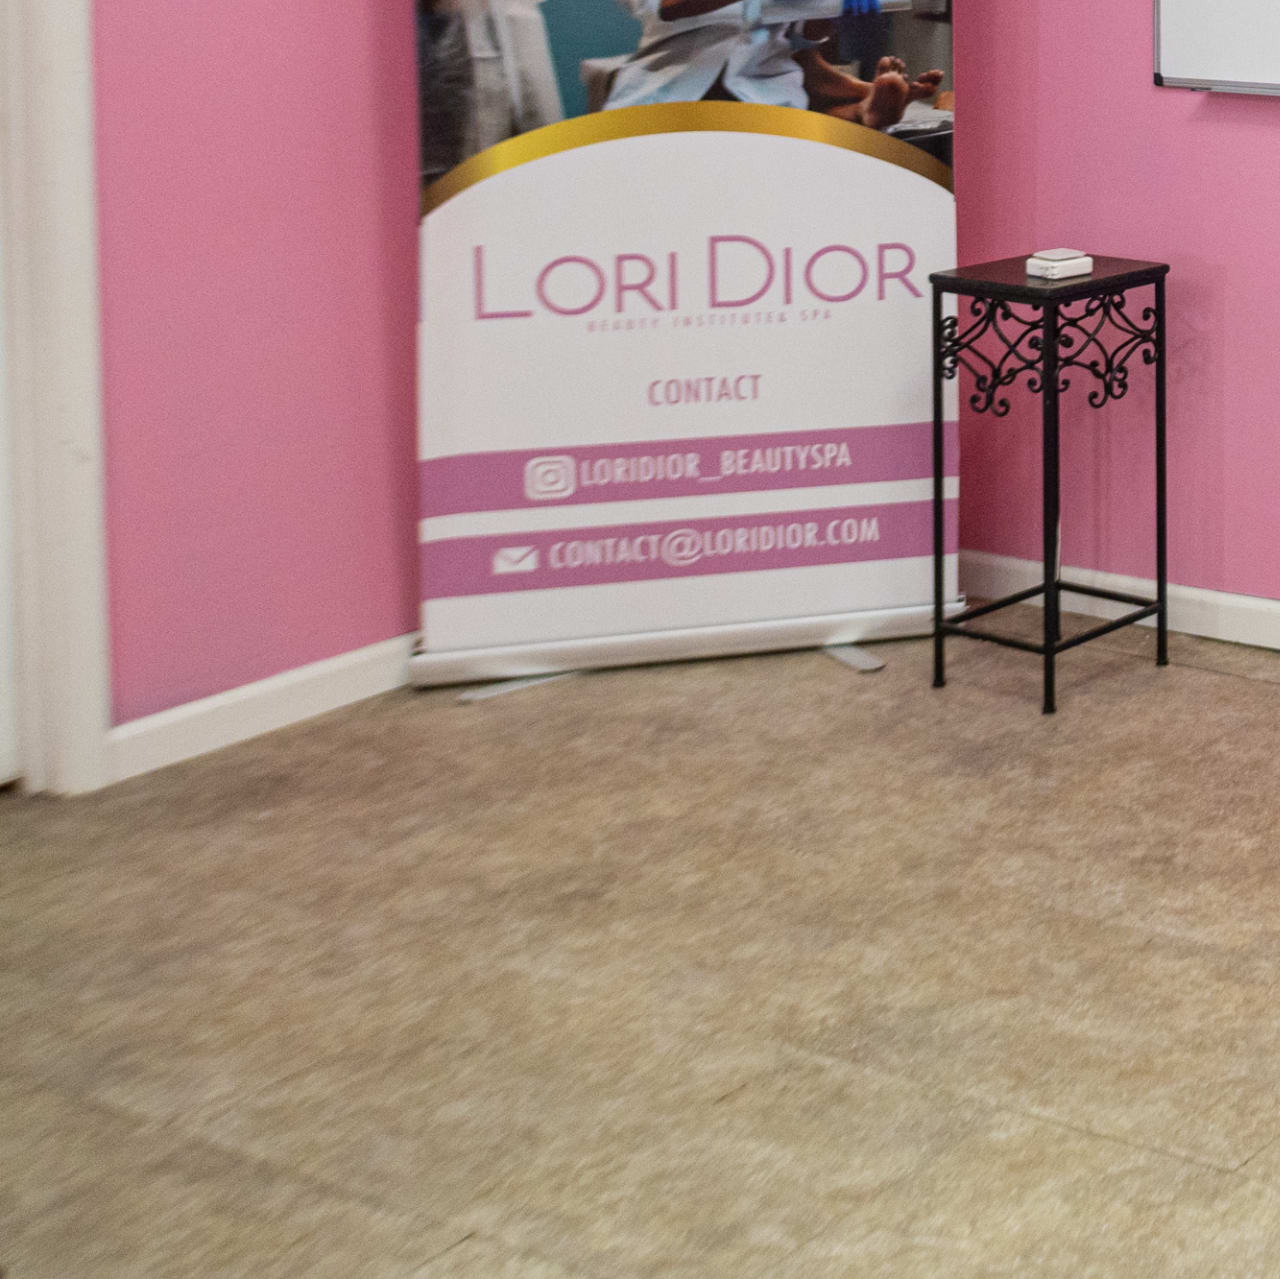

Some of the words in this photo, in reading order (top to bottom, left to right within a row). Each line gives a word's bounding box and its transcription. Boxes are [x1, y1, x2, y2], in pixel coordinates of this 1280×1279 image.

[473, 244, 679, 321] LORI
[706, 234, 925, 310] DIOR
[646, 374, 762, 406] CONTACT
[580, 442, 852, 486] LORIDIOR_BEAUTYSPA
[549, 517, 880, 567] CONTACT@LORIDIOR.COM
